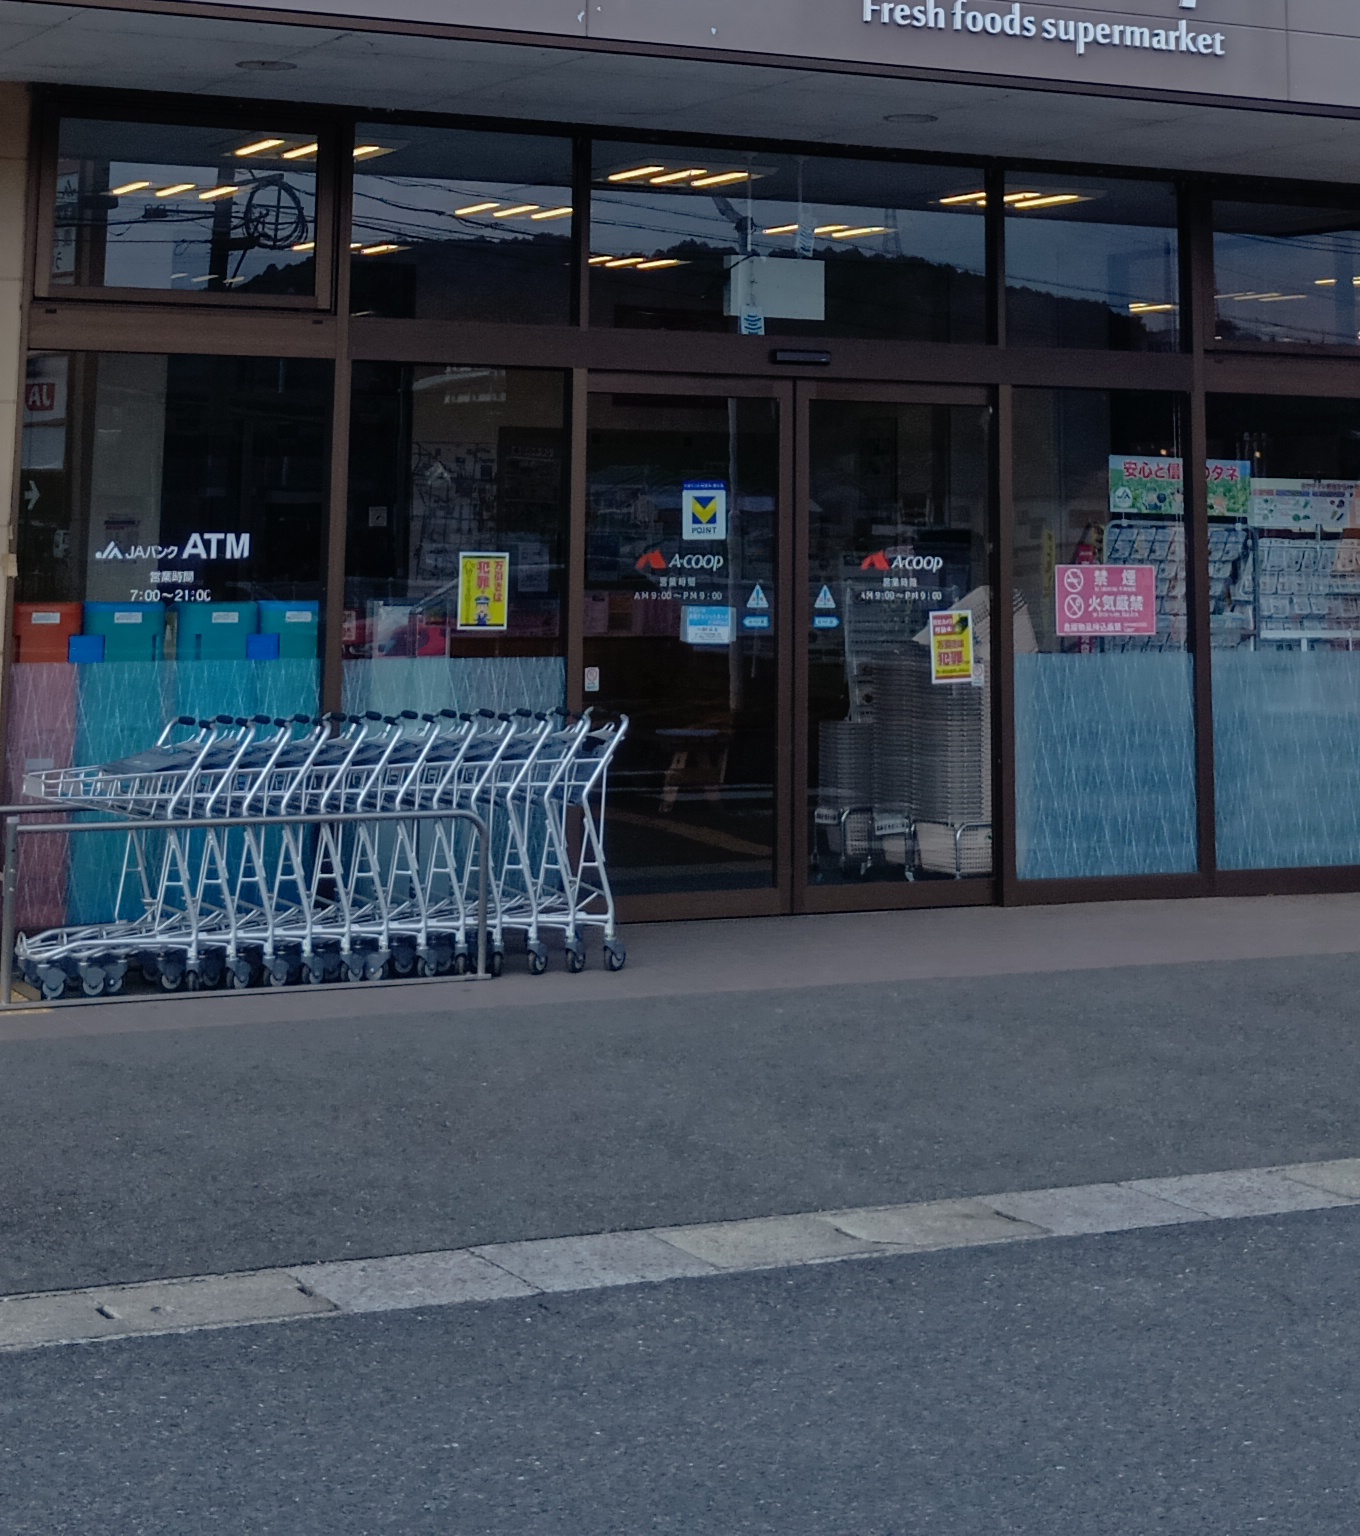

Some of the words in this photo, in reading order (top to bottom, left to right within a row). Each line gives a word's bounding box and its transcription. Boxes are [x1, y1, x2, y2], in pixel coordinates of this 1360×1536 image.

[1041, 19, 1226, 57] supermarket
[181, 533, 251, 559] ATM
[149, 570, 195, 584] 営業時間
[1088, 594, 1144, 611] 火気厳禁
